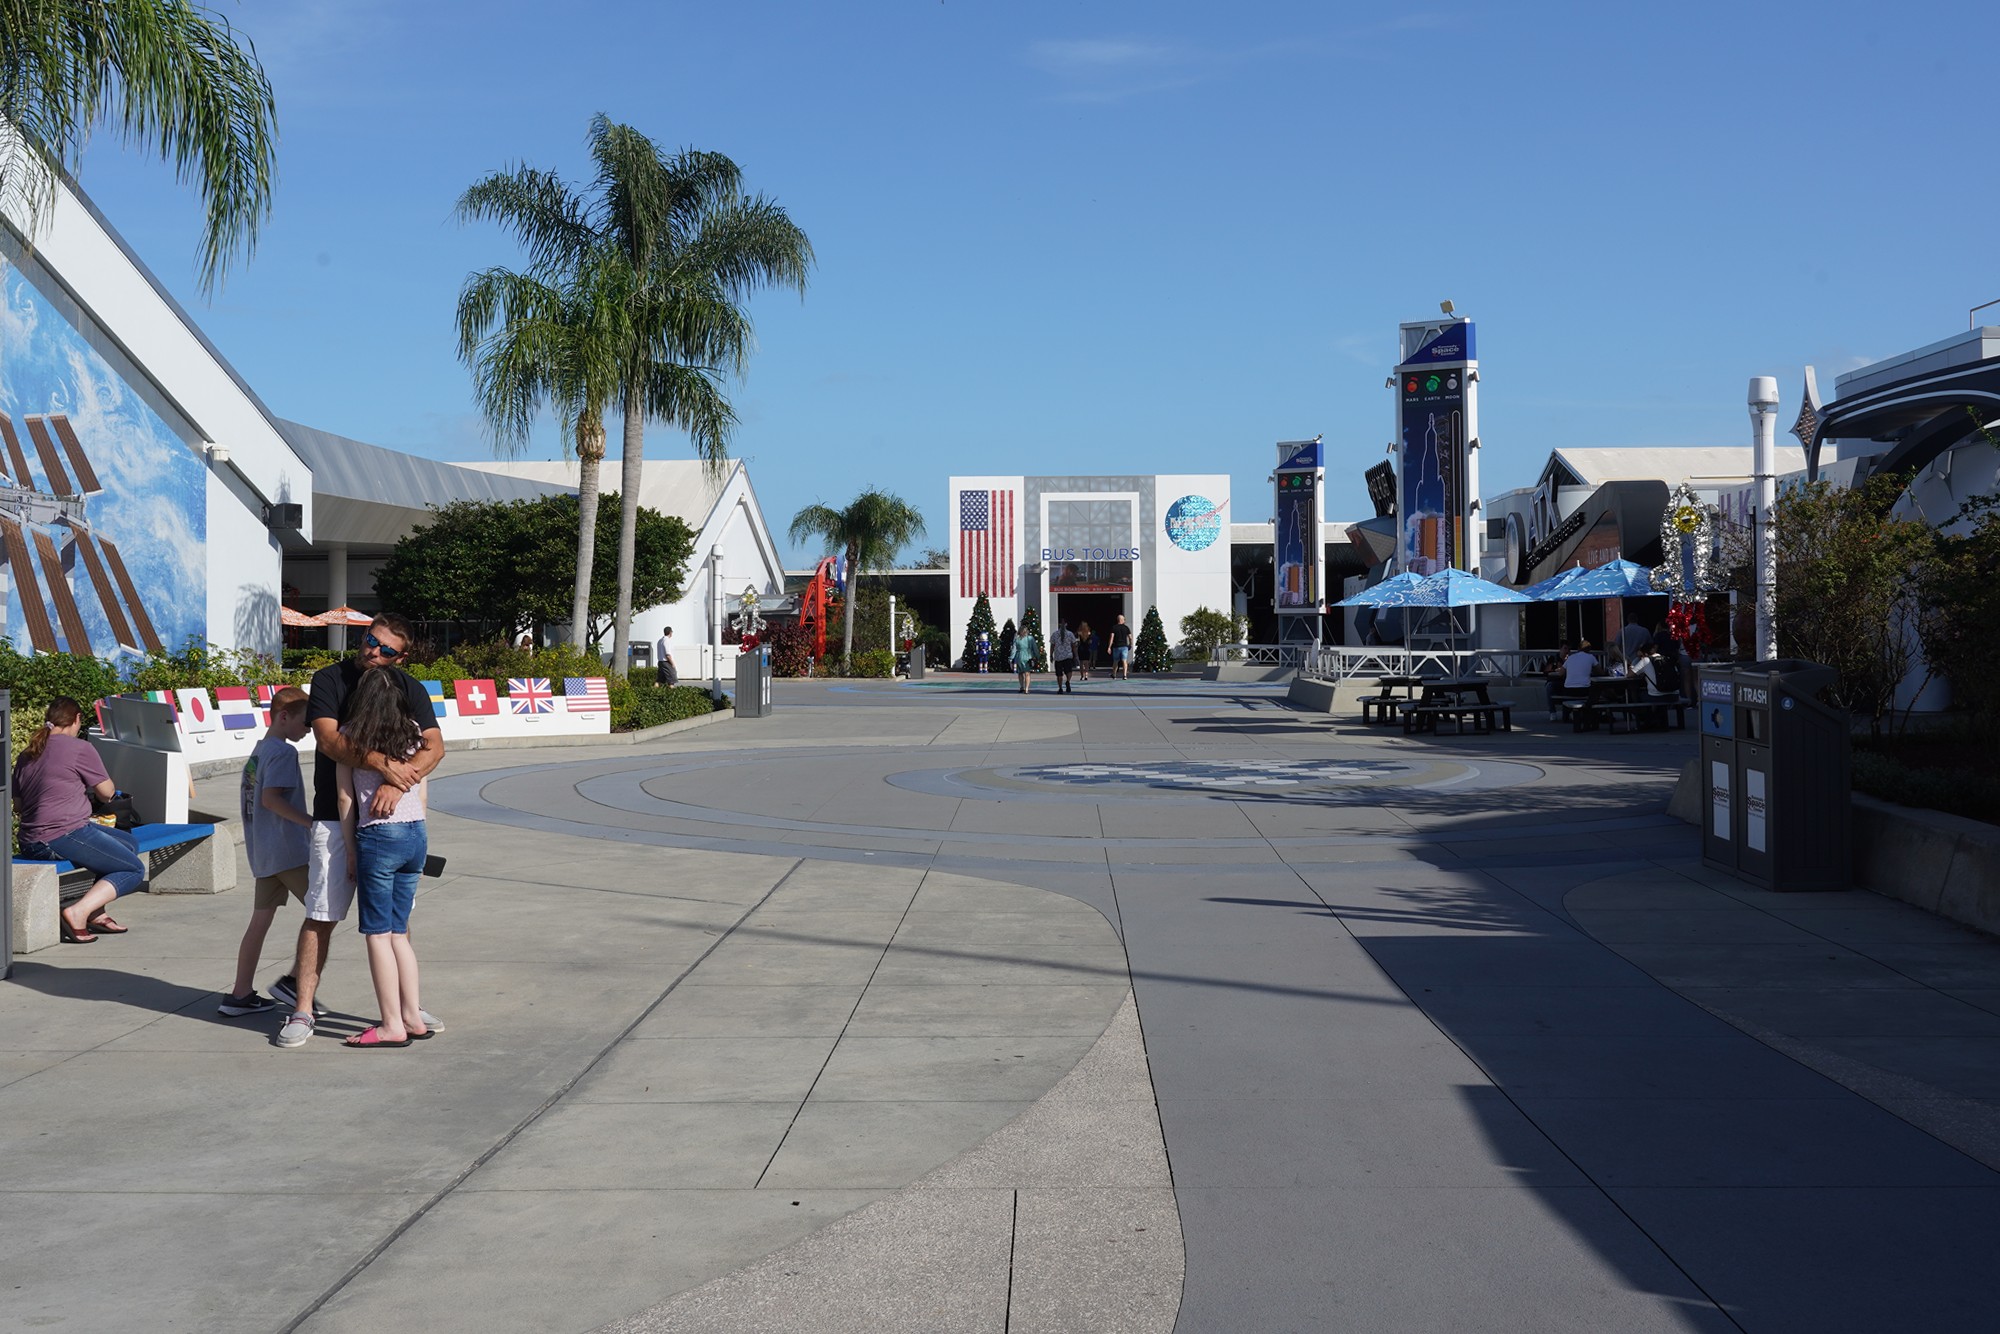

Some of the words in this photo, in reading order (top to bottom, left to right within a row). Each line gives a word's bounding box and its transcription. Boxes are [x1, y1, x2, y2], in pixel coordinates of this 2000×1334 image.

[1042, 548, 1075, 561] BUS
[1082, 547, 1140, 560] TOURS
[1708, 682, 1731, 696] RECYCLE
[1743, 687, 1767, 705] TRASH
[1713, 787, 1730, 799] Space
[1747, 796, 1765, 809] Space
